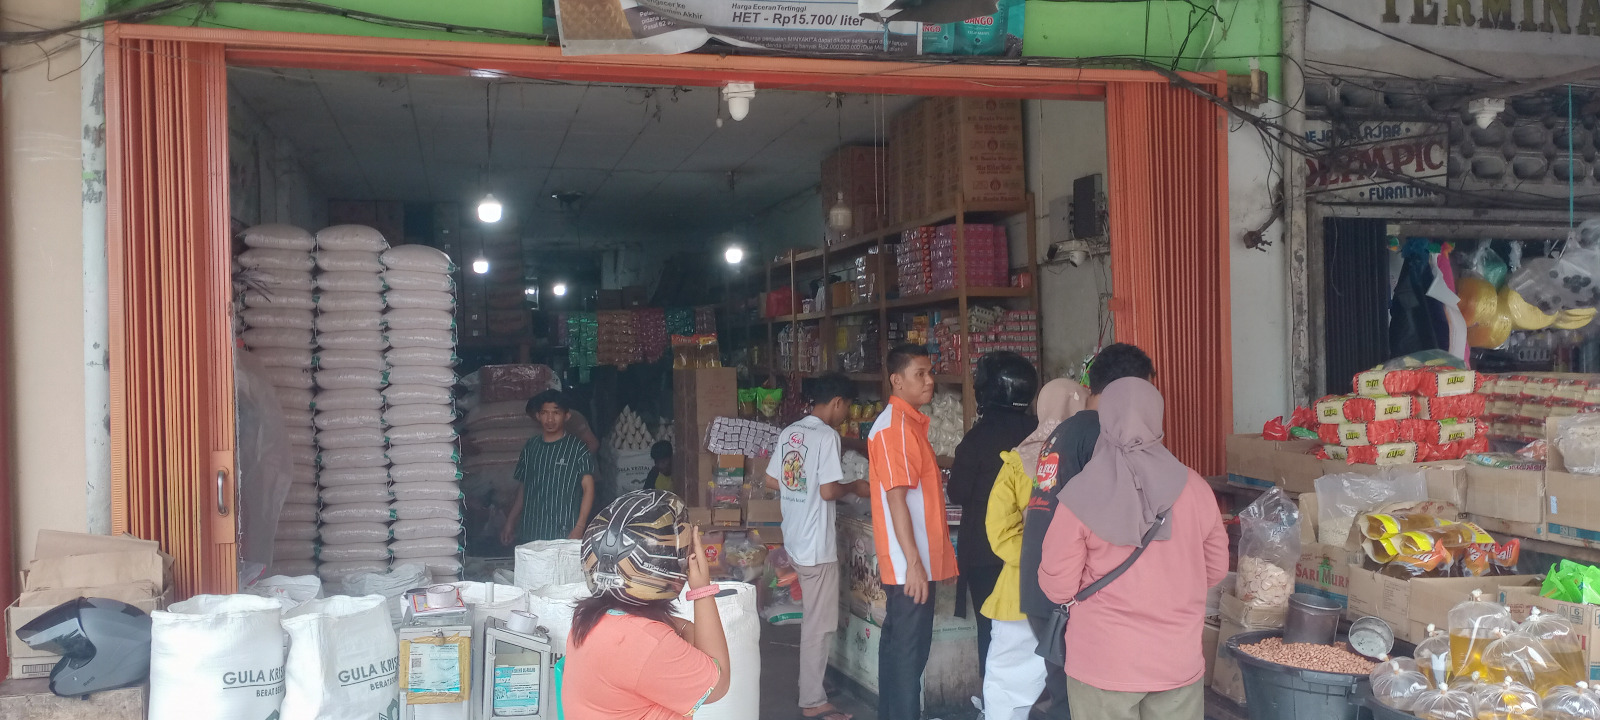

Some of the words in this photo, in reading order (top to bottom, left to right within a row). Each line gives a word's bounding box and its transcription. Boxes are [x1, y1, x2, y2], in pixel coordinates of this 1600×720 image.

[682, 11, 703, 20] Akhir
[732, 3, 752, 11] Harga
[777, 5, 807, 13] Tertinggi
[732, 12, 761, 23] HET
[772, 13, 837, 27] Rp15.700/
[840, 15, 865, 26] liter
[1296, 563, 1319, 582] SARI
[222, 669, 266, 685] GULA
[269, 665, 285, 682] KRIS
[338, 663, 378, 683] GULA
[380, 655, 400, 673] KRIS
[256, 688, 275, 697] BERAT
